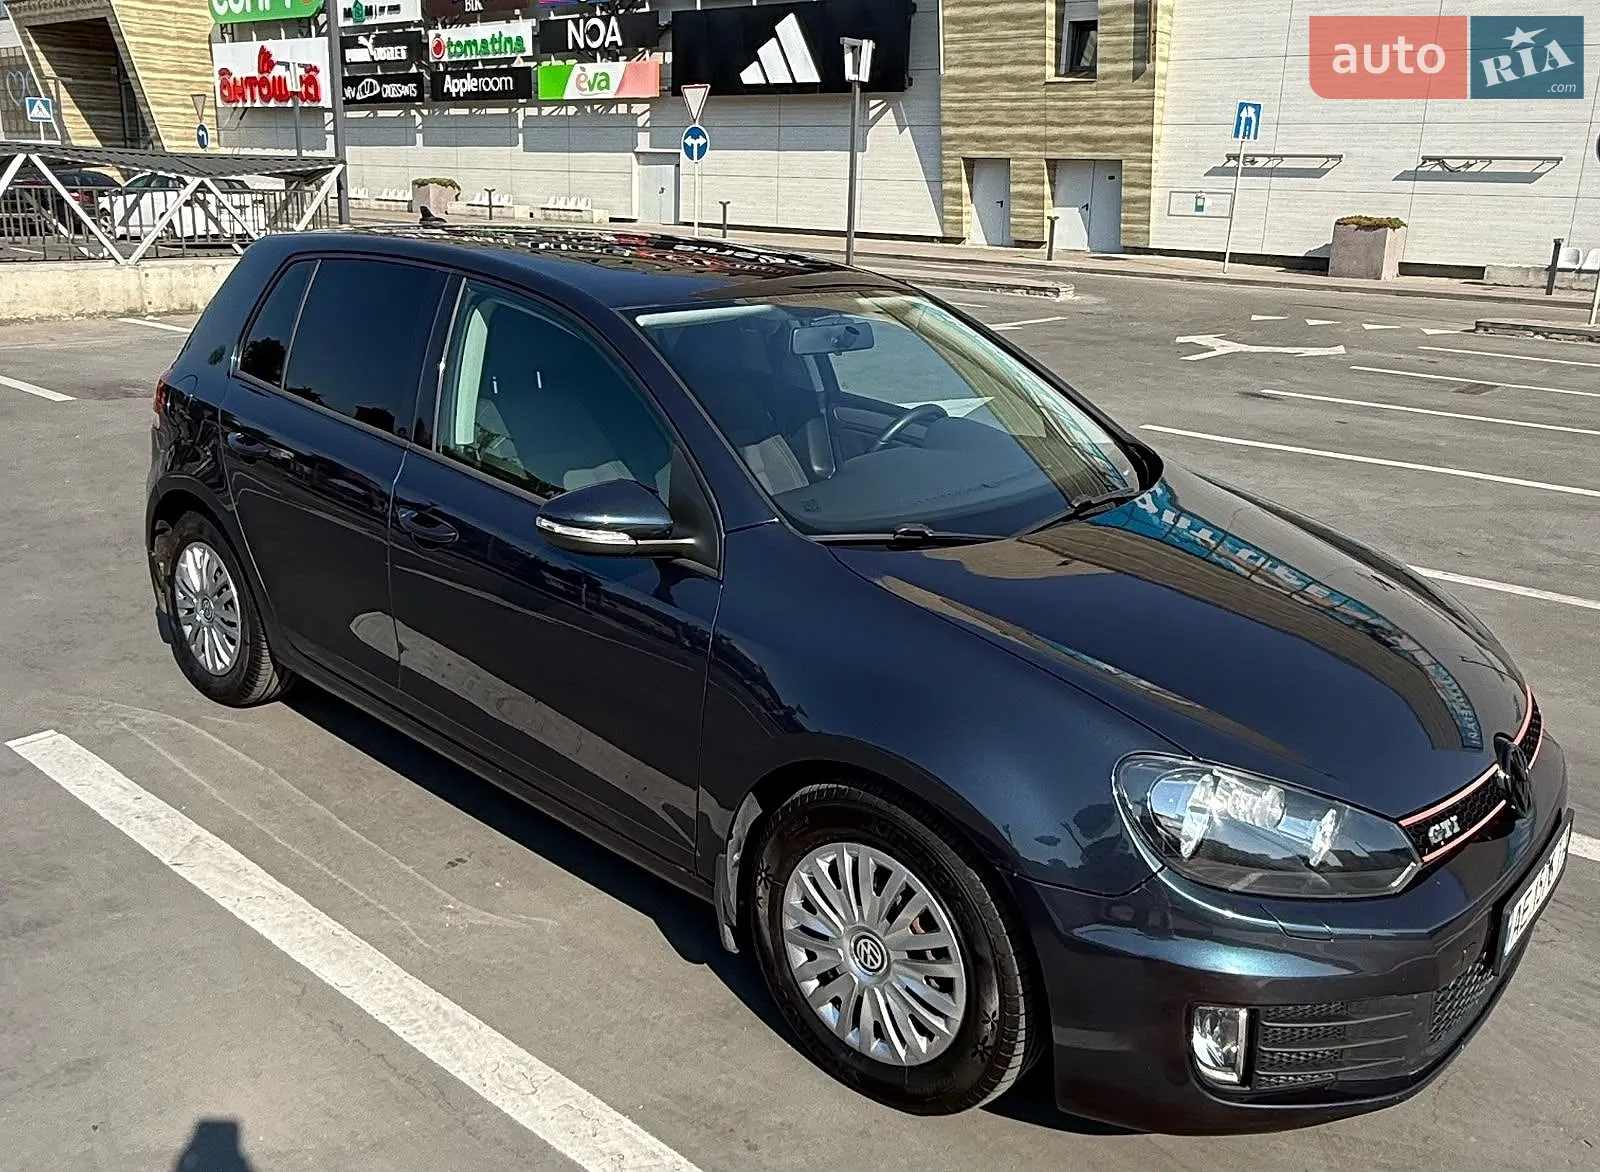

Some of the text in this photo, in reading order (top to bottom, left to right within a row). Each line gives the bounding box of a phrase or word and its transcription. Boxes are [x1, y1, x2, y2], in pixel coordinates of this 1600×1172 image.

[446, 31, 526, 59] tomatina
[568, 16, 622, 49] NOA
[443, 73, 514, 97] Appleroom
[1428, 815, 1461, 845] GTI
